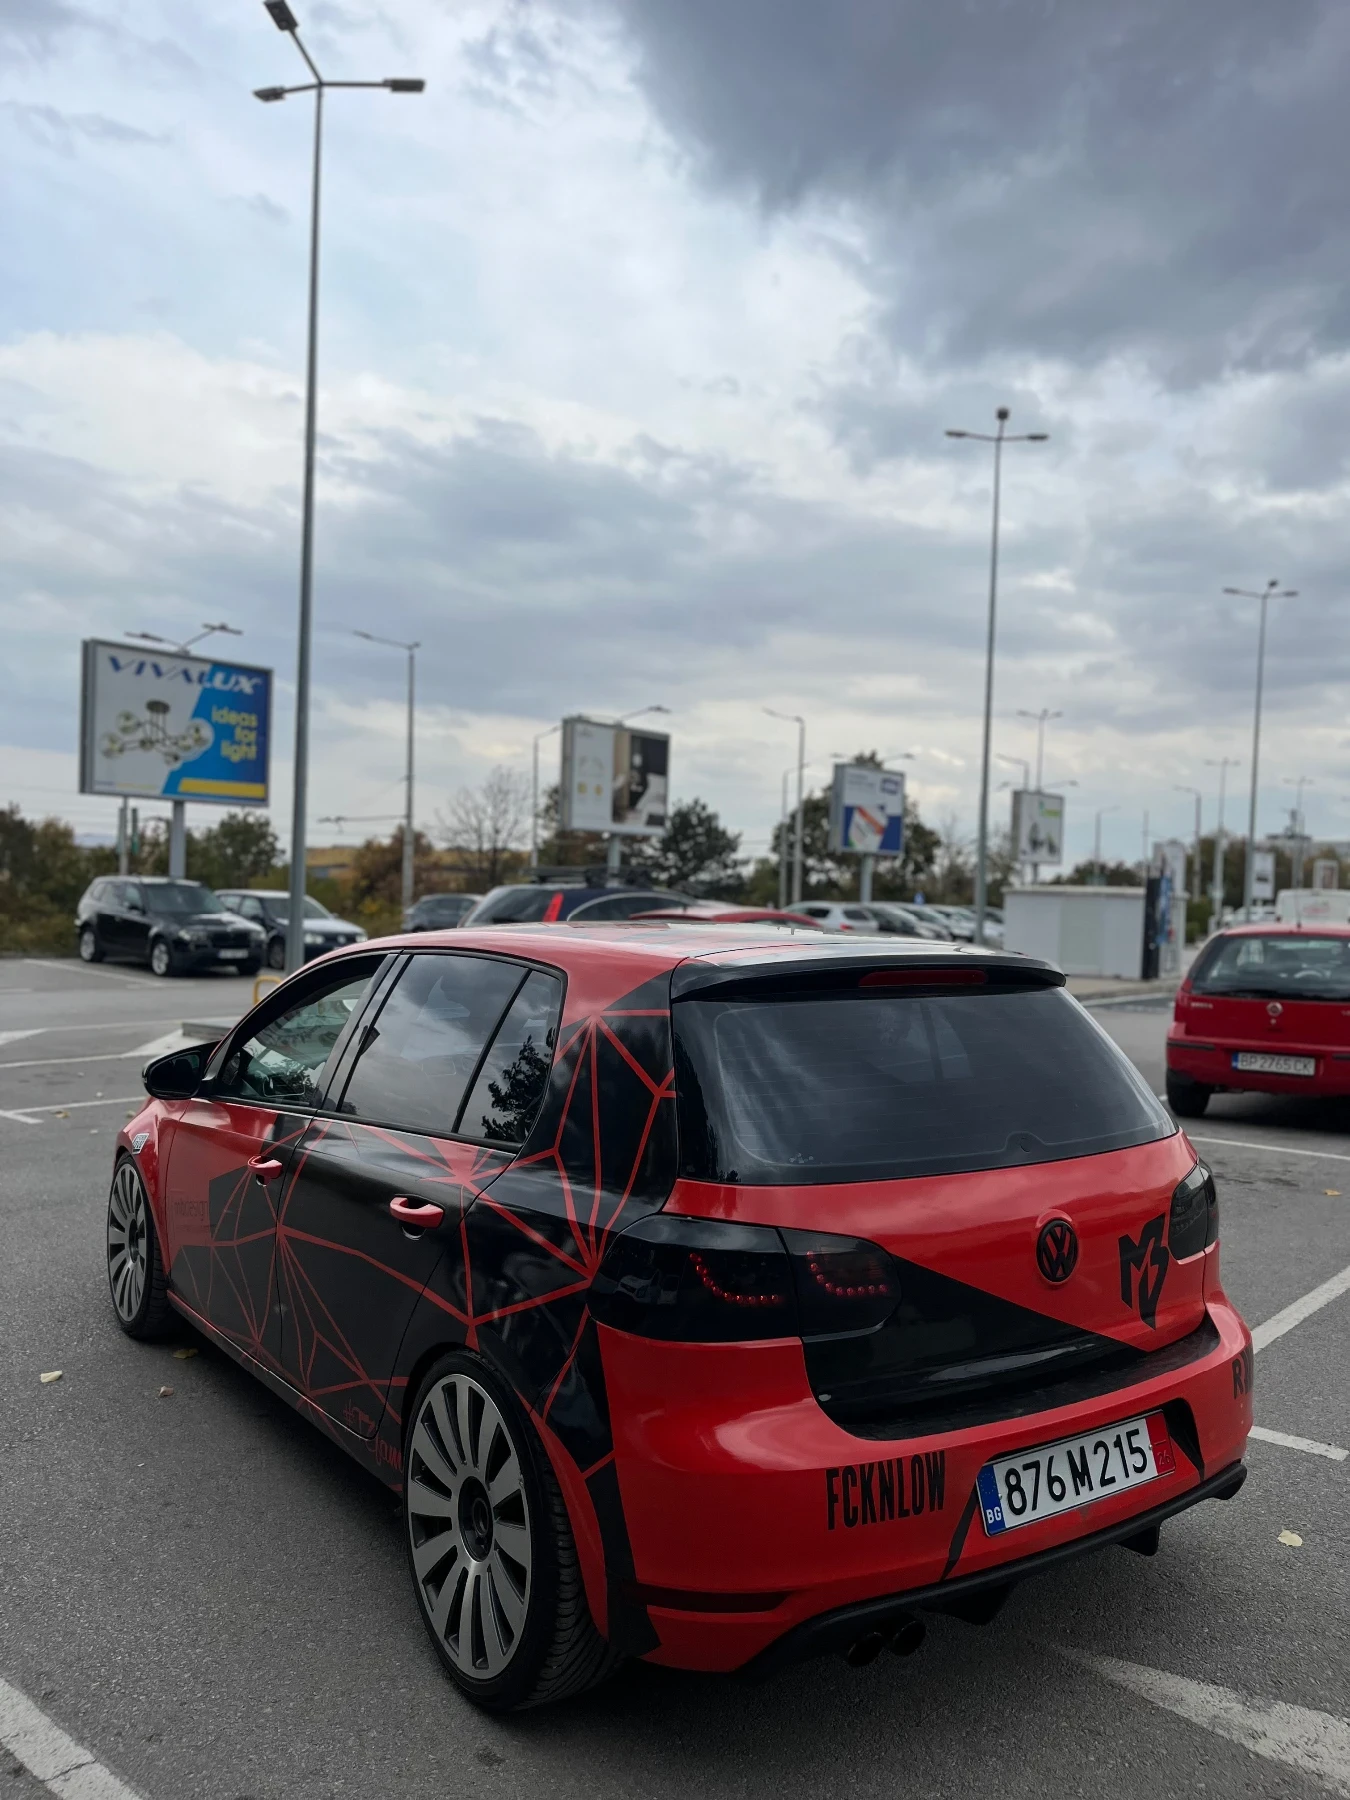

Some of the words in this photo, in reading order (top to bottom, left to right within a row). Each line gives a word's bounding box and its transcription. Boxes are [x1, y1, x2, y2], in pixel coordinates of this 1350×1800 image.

[109, 655, 262, 694] VIVALUX
[826, 1450, 945, 1530] FCKNLOW
[985, 1507, 1002, 1524] BG
